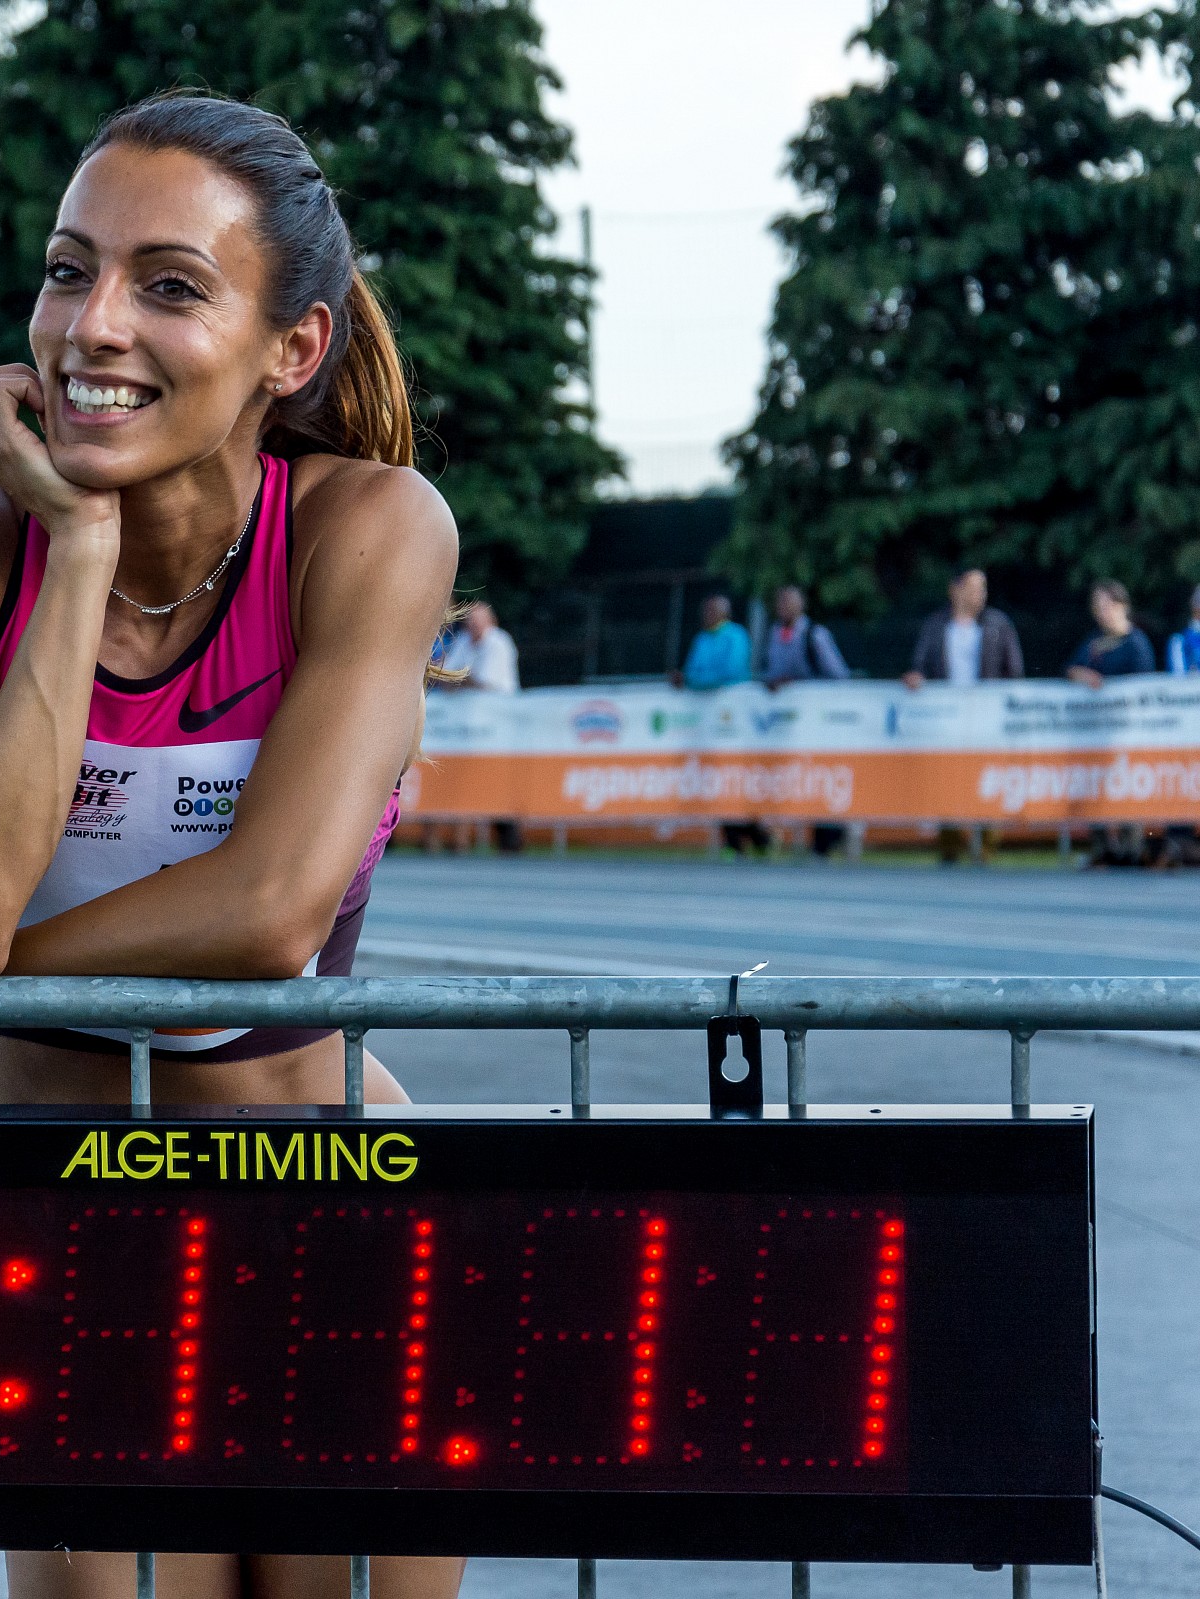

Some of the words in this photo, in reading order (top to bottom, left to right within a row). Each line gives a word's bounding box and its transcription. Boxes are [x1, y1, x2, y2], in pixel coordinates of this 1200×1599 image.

[566, 756, 852, 812] #gavardomeeting
[63, 829, 122, 841] OMPUTER
[58, 1130, 420, 1182] ALGE-TIMING
